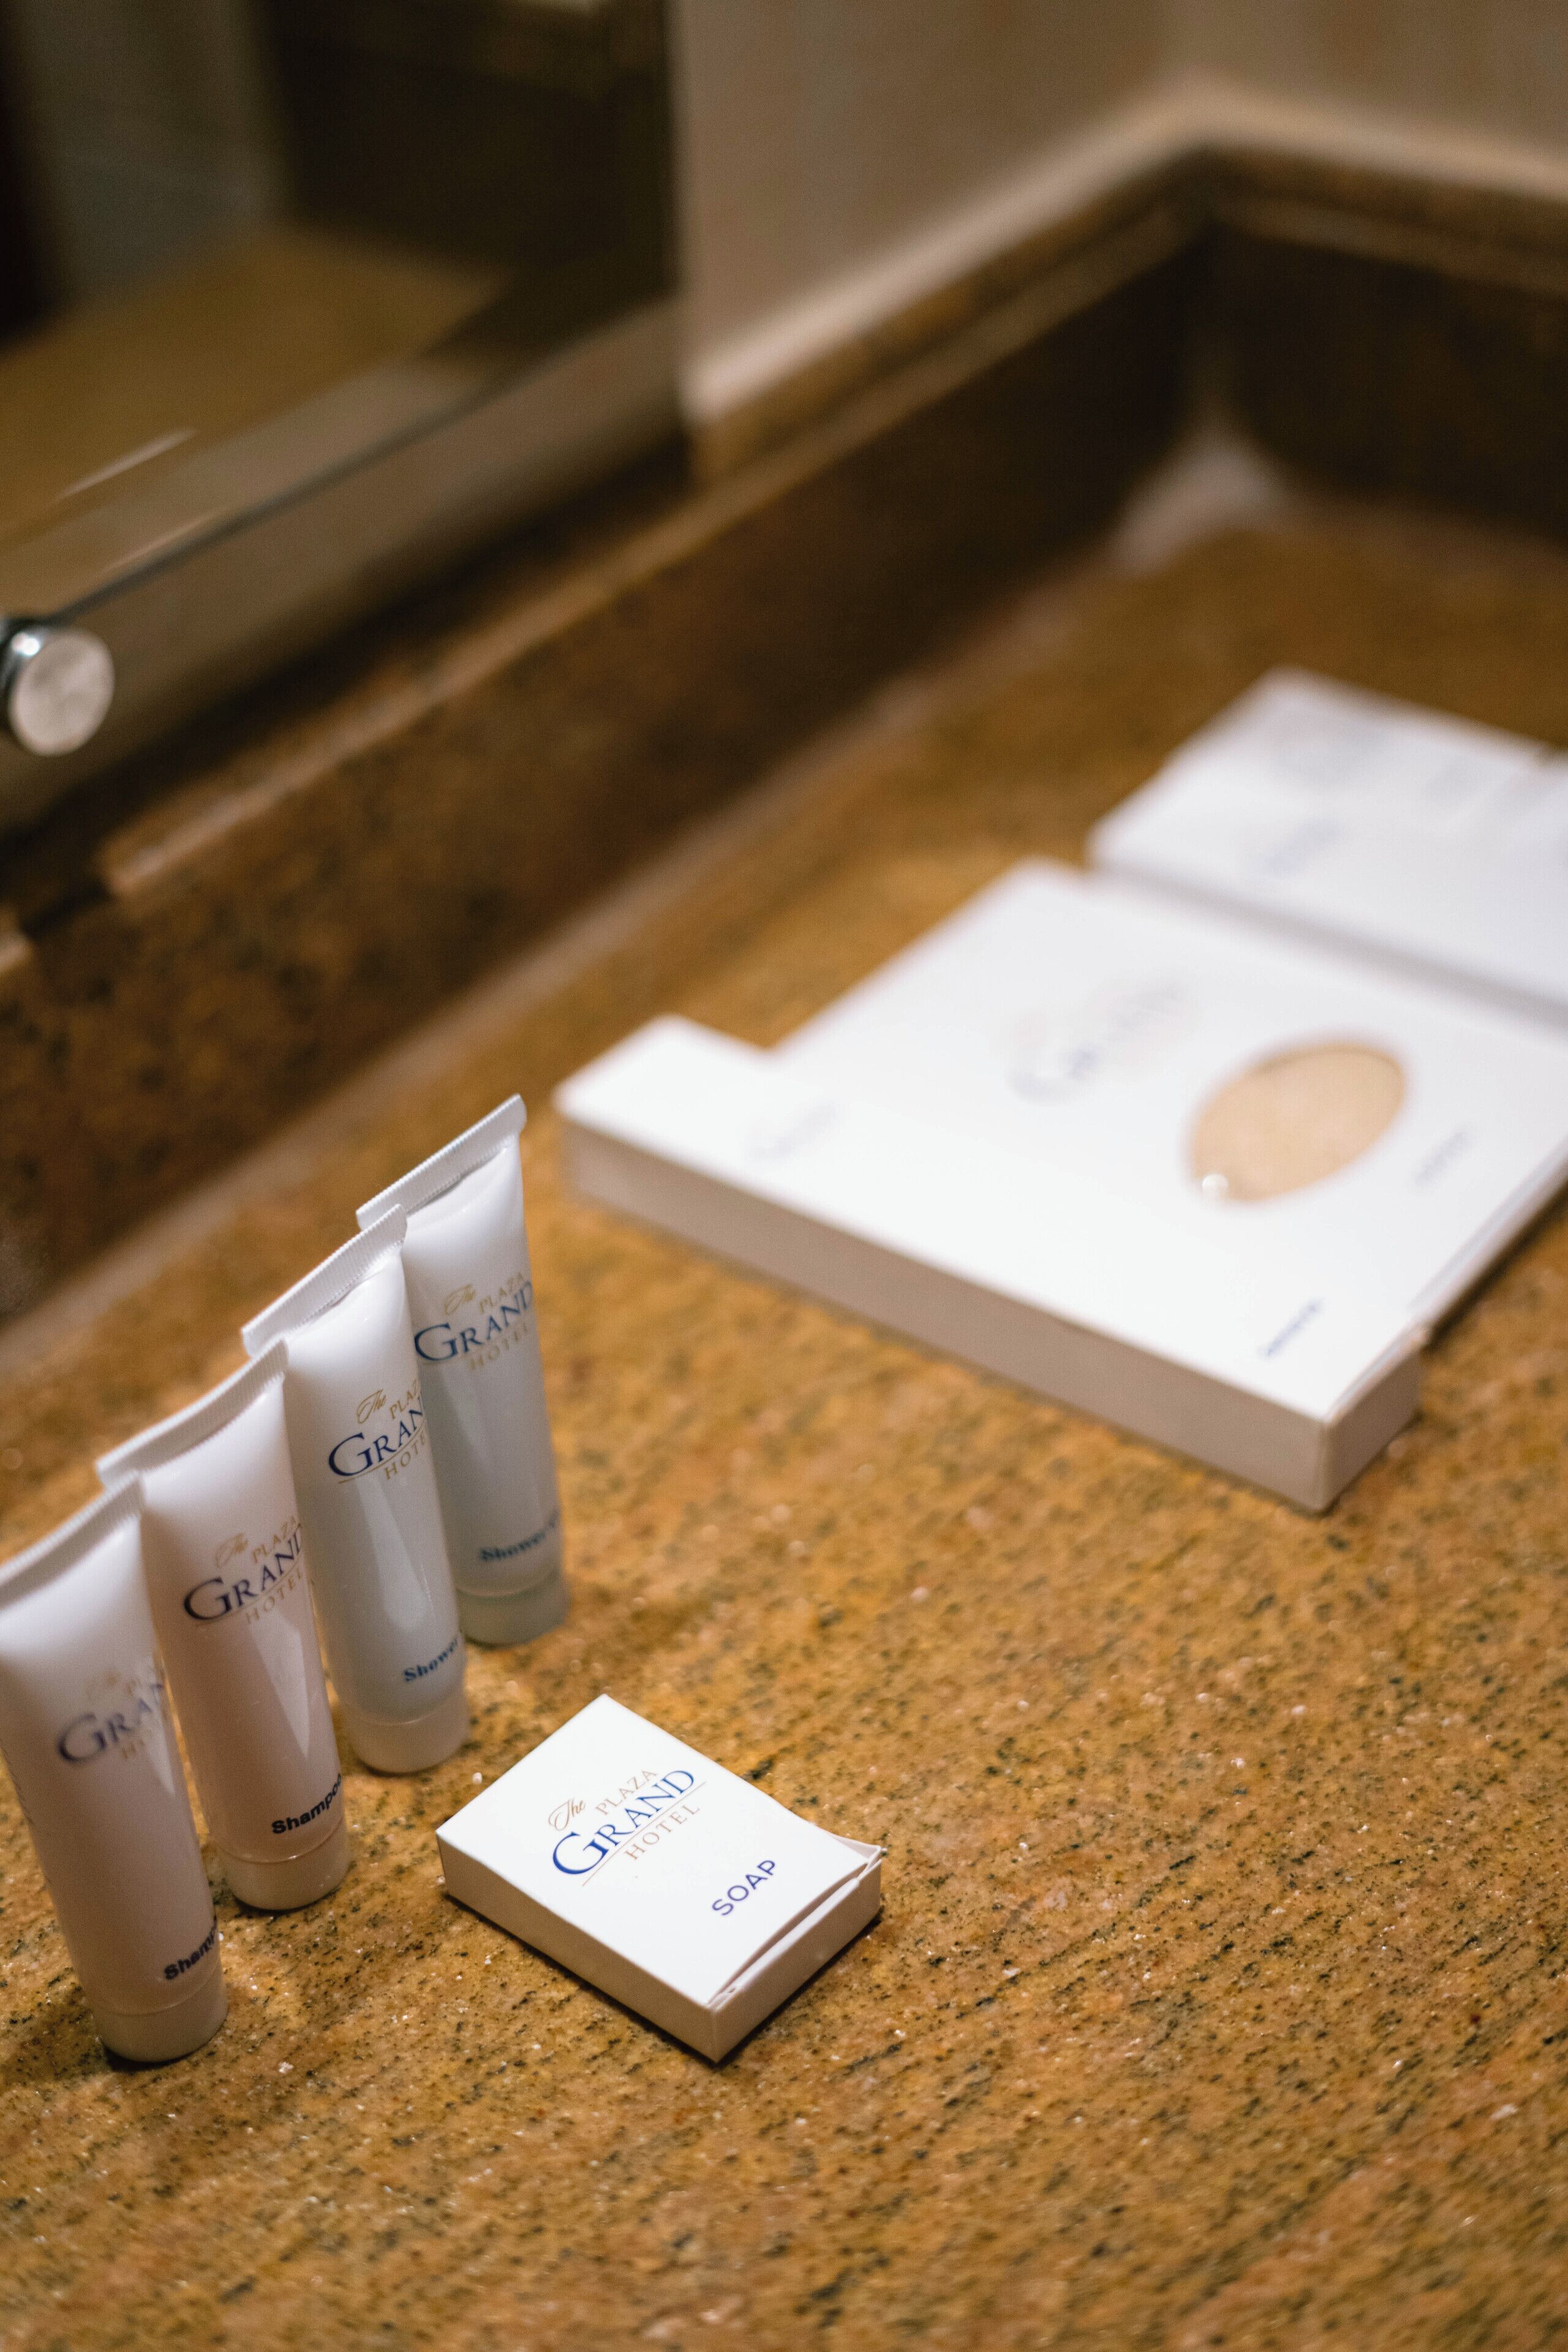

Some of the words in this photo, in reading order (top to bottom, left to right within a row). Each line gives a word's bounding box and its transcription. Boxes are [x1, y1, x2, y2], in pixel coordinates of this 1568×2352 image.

[356, 1389, 386, 1424] The
[390, 1379, 420, 1420] PLAZ
[328, 1395, 424, 1477] GRAN
[548, 1798, 586, 1831] The
[594, 1769, 658, 1816] PLAZA
[552, 1770, 695, 1875] GRAND
[624, 1803, 701, 1861] HOTEL
[711, 1860, 776, 1917] SOAP
